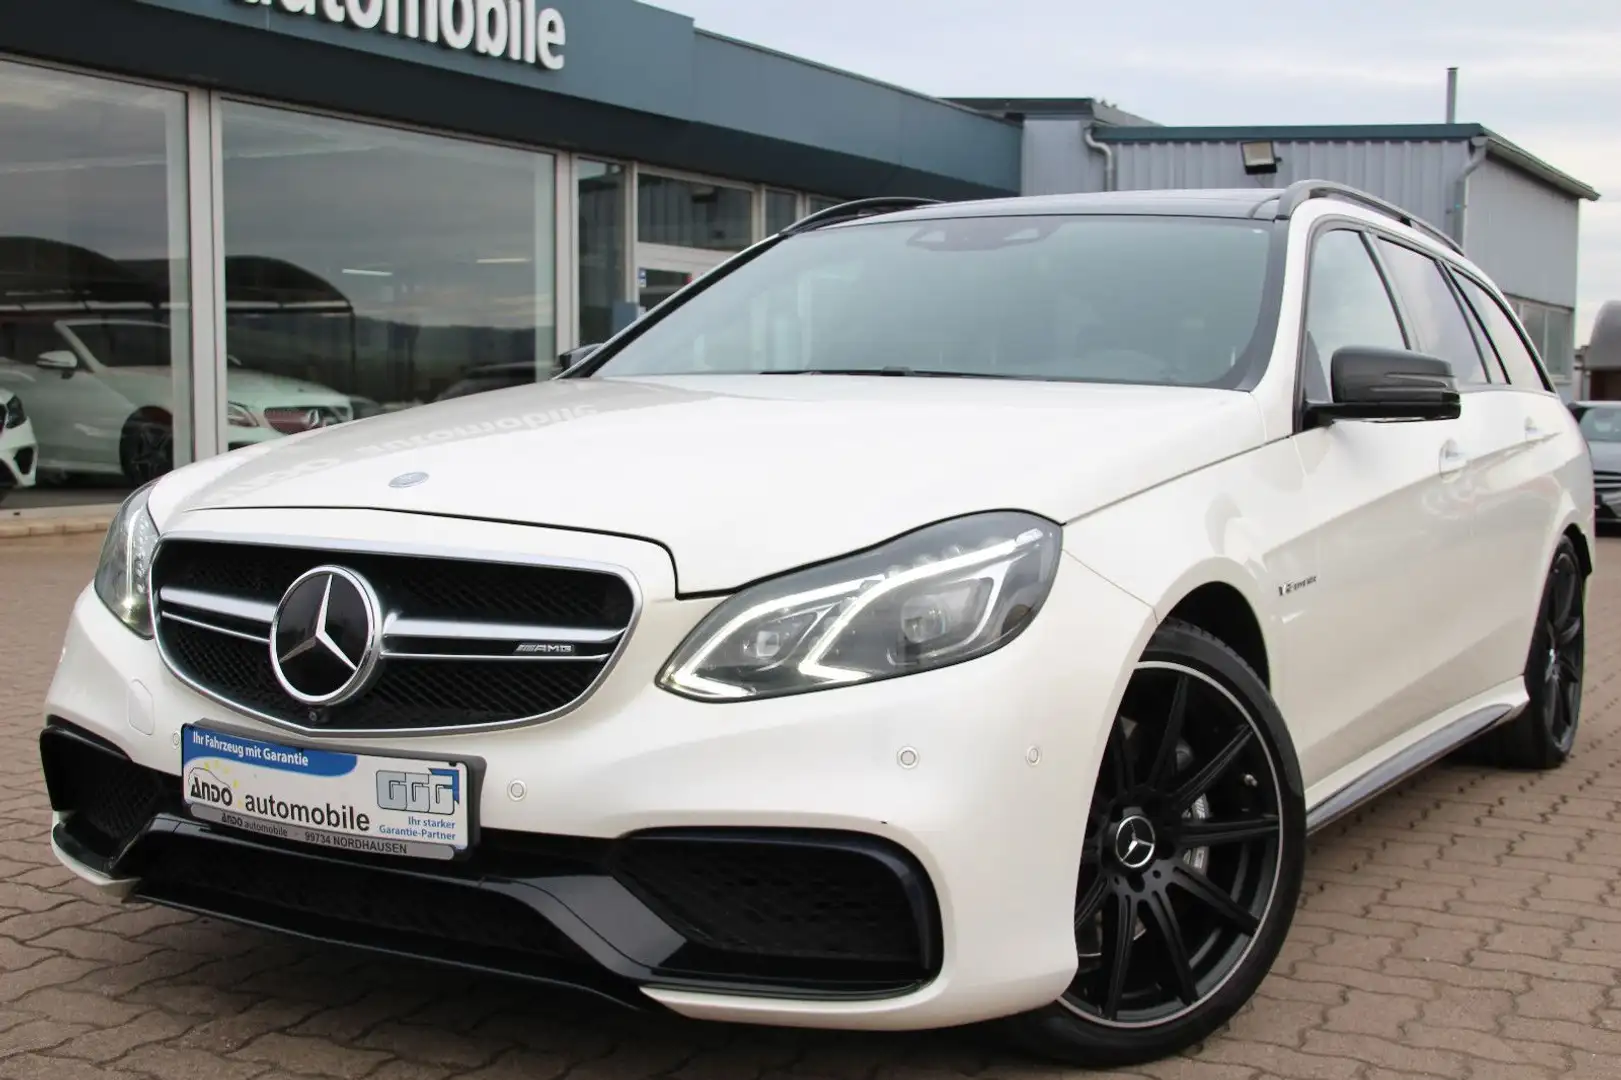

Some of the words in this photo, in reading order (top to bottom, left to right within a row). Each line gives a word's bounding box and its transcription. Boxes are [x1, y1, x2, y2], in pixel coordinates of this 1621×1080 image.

[244, 0, 566, 70] mobile
[533, 643, 573, 653] AMG
[193, 731, 204, 745] Ihr
[205, 734, 244, 757] Fahrzeug
[245, 745, 262, 759] mit
[263, 747, 309, 767] Garantie
[245, 794, 370, 831] automobile
[408, 816, 421, 826] Ihr
[423, 817, 456, 829] starker
[244, 820, 288, 836] automobile
[304, 831, 332, 844] 99734
[333, 836, 407, 854] NORDHAUSEN
[379, 825, 456, 840] Garantie-Partner
